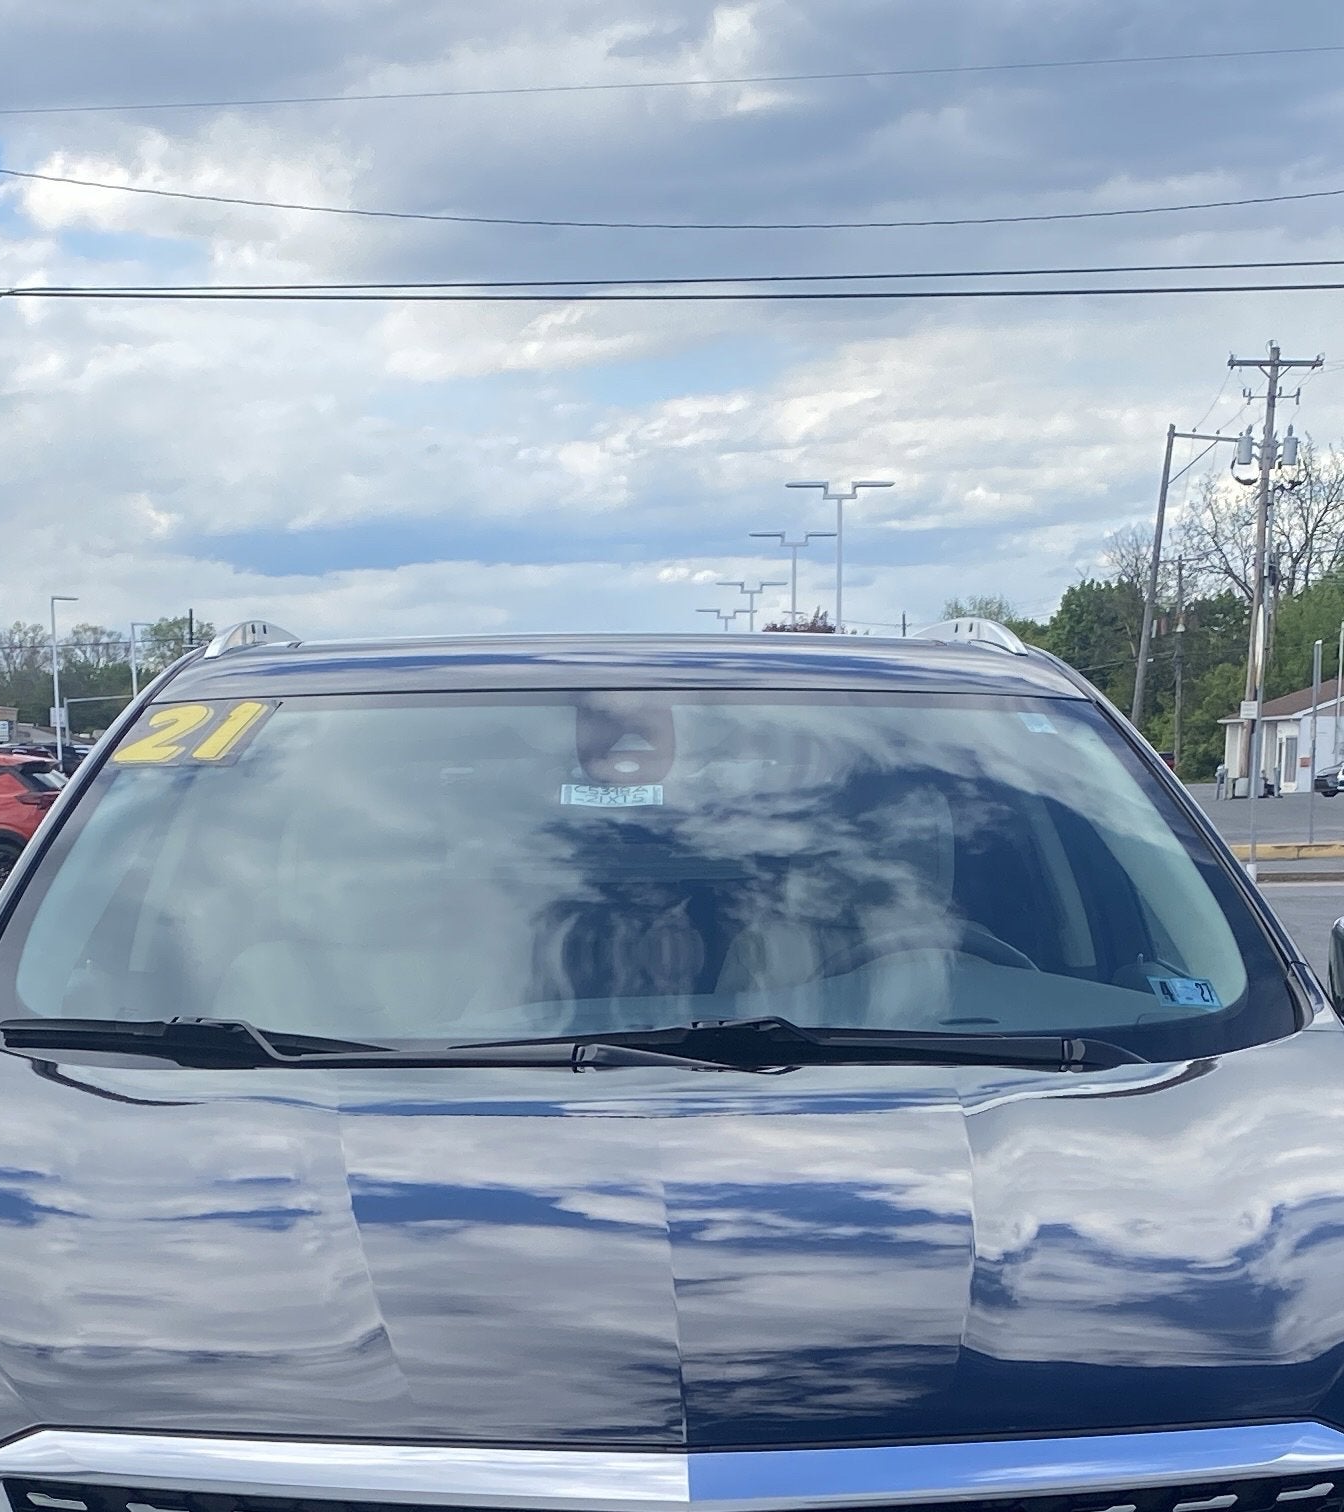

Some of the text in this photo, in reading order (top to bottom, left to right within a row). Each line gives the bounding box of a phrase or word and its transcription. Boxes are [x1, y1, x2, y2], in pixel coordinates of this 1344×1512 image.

[112, 702, 268, 764] 21
[1159, 981, 1214, 1003] 4 27
